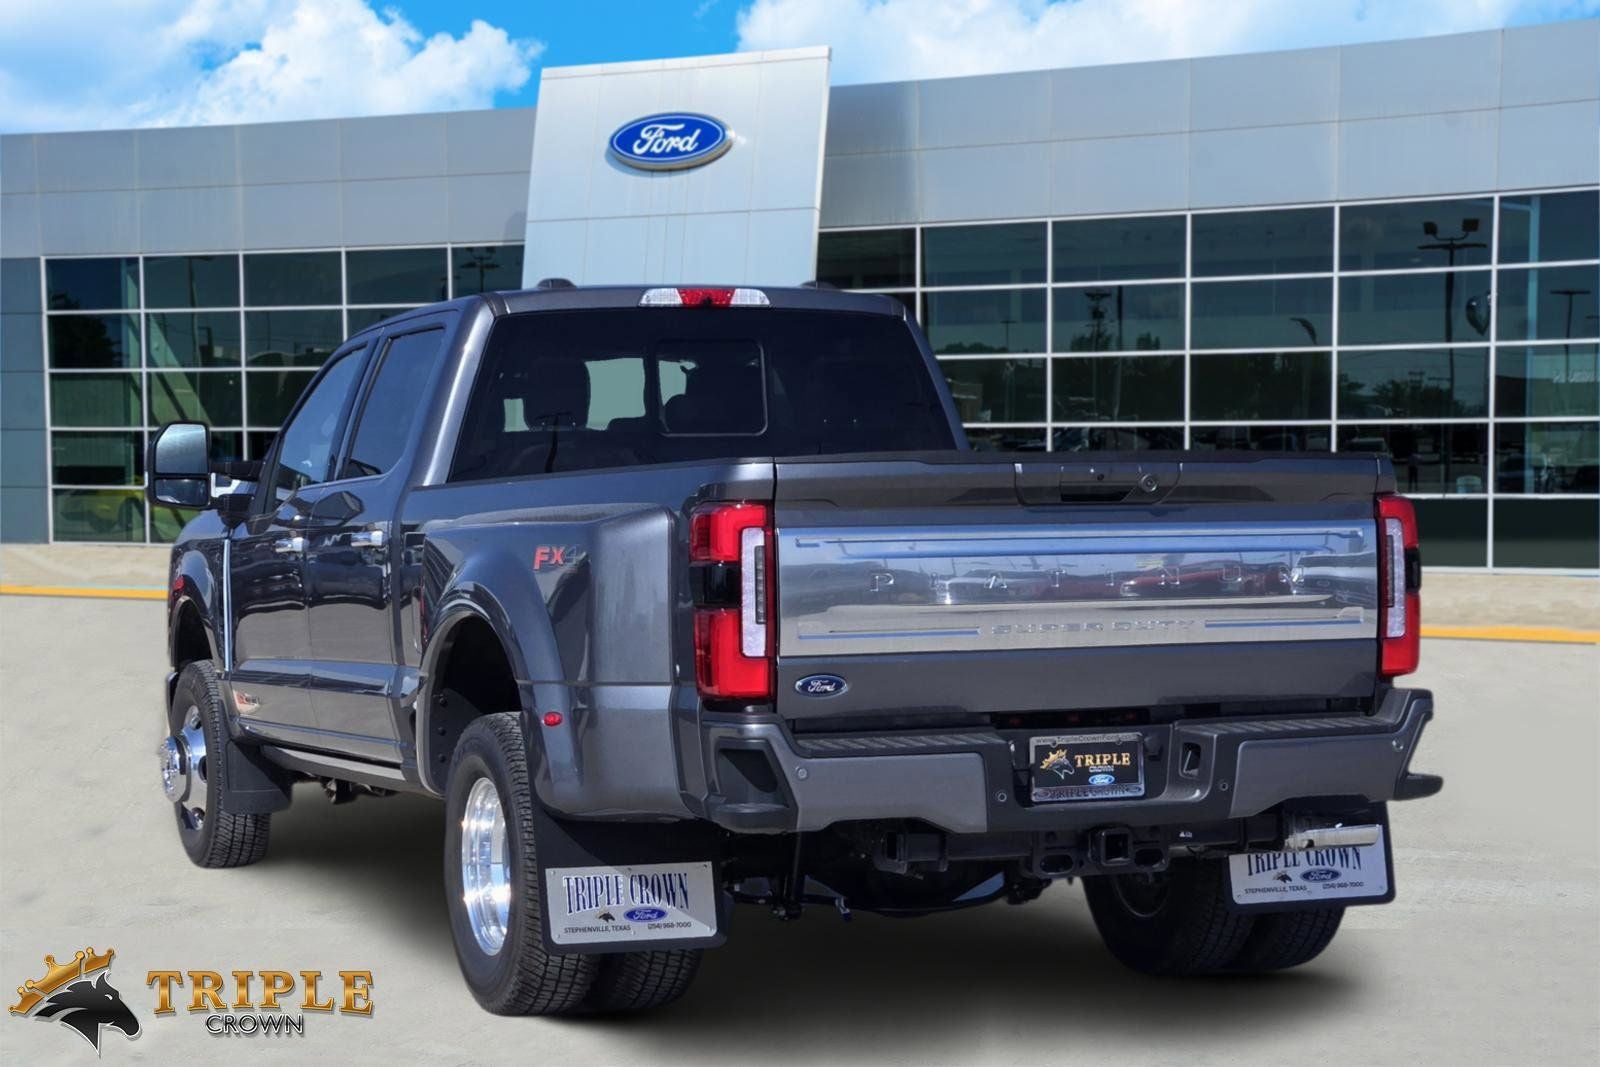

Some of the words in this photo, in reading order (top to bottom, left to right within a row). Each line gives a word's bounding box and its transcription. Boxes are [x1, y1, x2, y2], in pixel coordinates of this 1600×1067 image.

[633, 123, 701, 155] Ford
[991, 623, 1104, 635] SUPER
[1111, 619, 1195, 632] DUTY
[808, 679, 836, 692] Ford
[1074, 753, 1131, 767] TRIPLE
[1089, 765, 1114, 773] CROWN
[563, 875, 625, 915] TRIPLE
[629, 872, 690, 909] CROWN
[633, 909, 658, 920] Ford
[564, 925, 611, 935] STEPHENVILLE,
[611, 924, 632, 932] TEXAS
